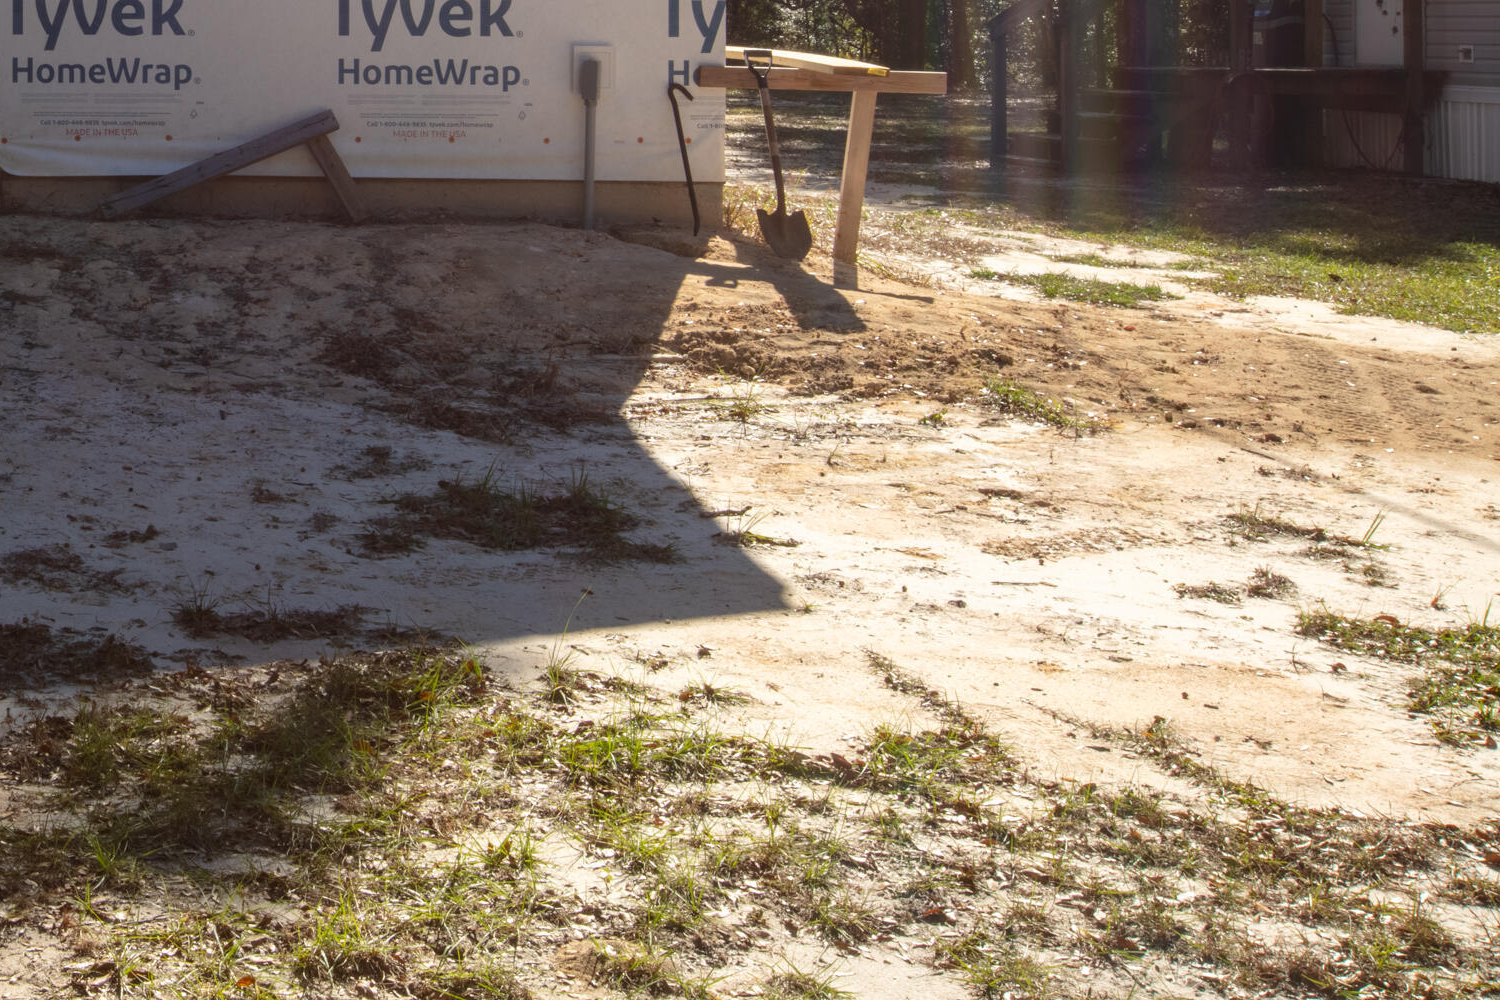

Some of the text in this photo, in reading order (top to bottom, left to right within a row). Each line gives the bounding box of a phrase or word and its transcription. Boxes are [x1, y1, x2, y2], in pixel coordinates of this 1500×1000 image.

[12, 57, 192, 90] HomeWrap
[338, 58, 521, 92] HomeWrap
[66, 128, 138, 136] MADE IN THE USA
